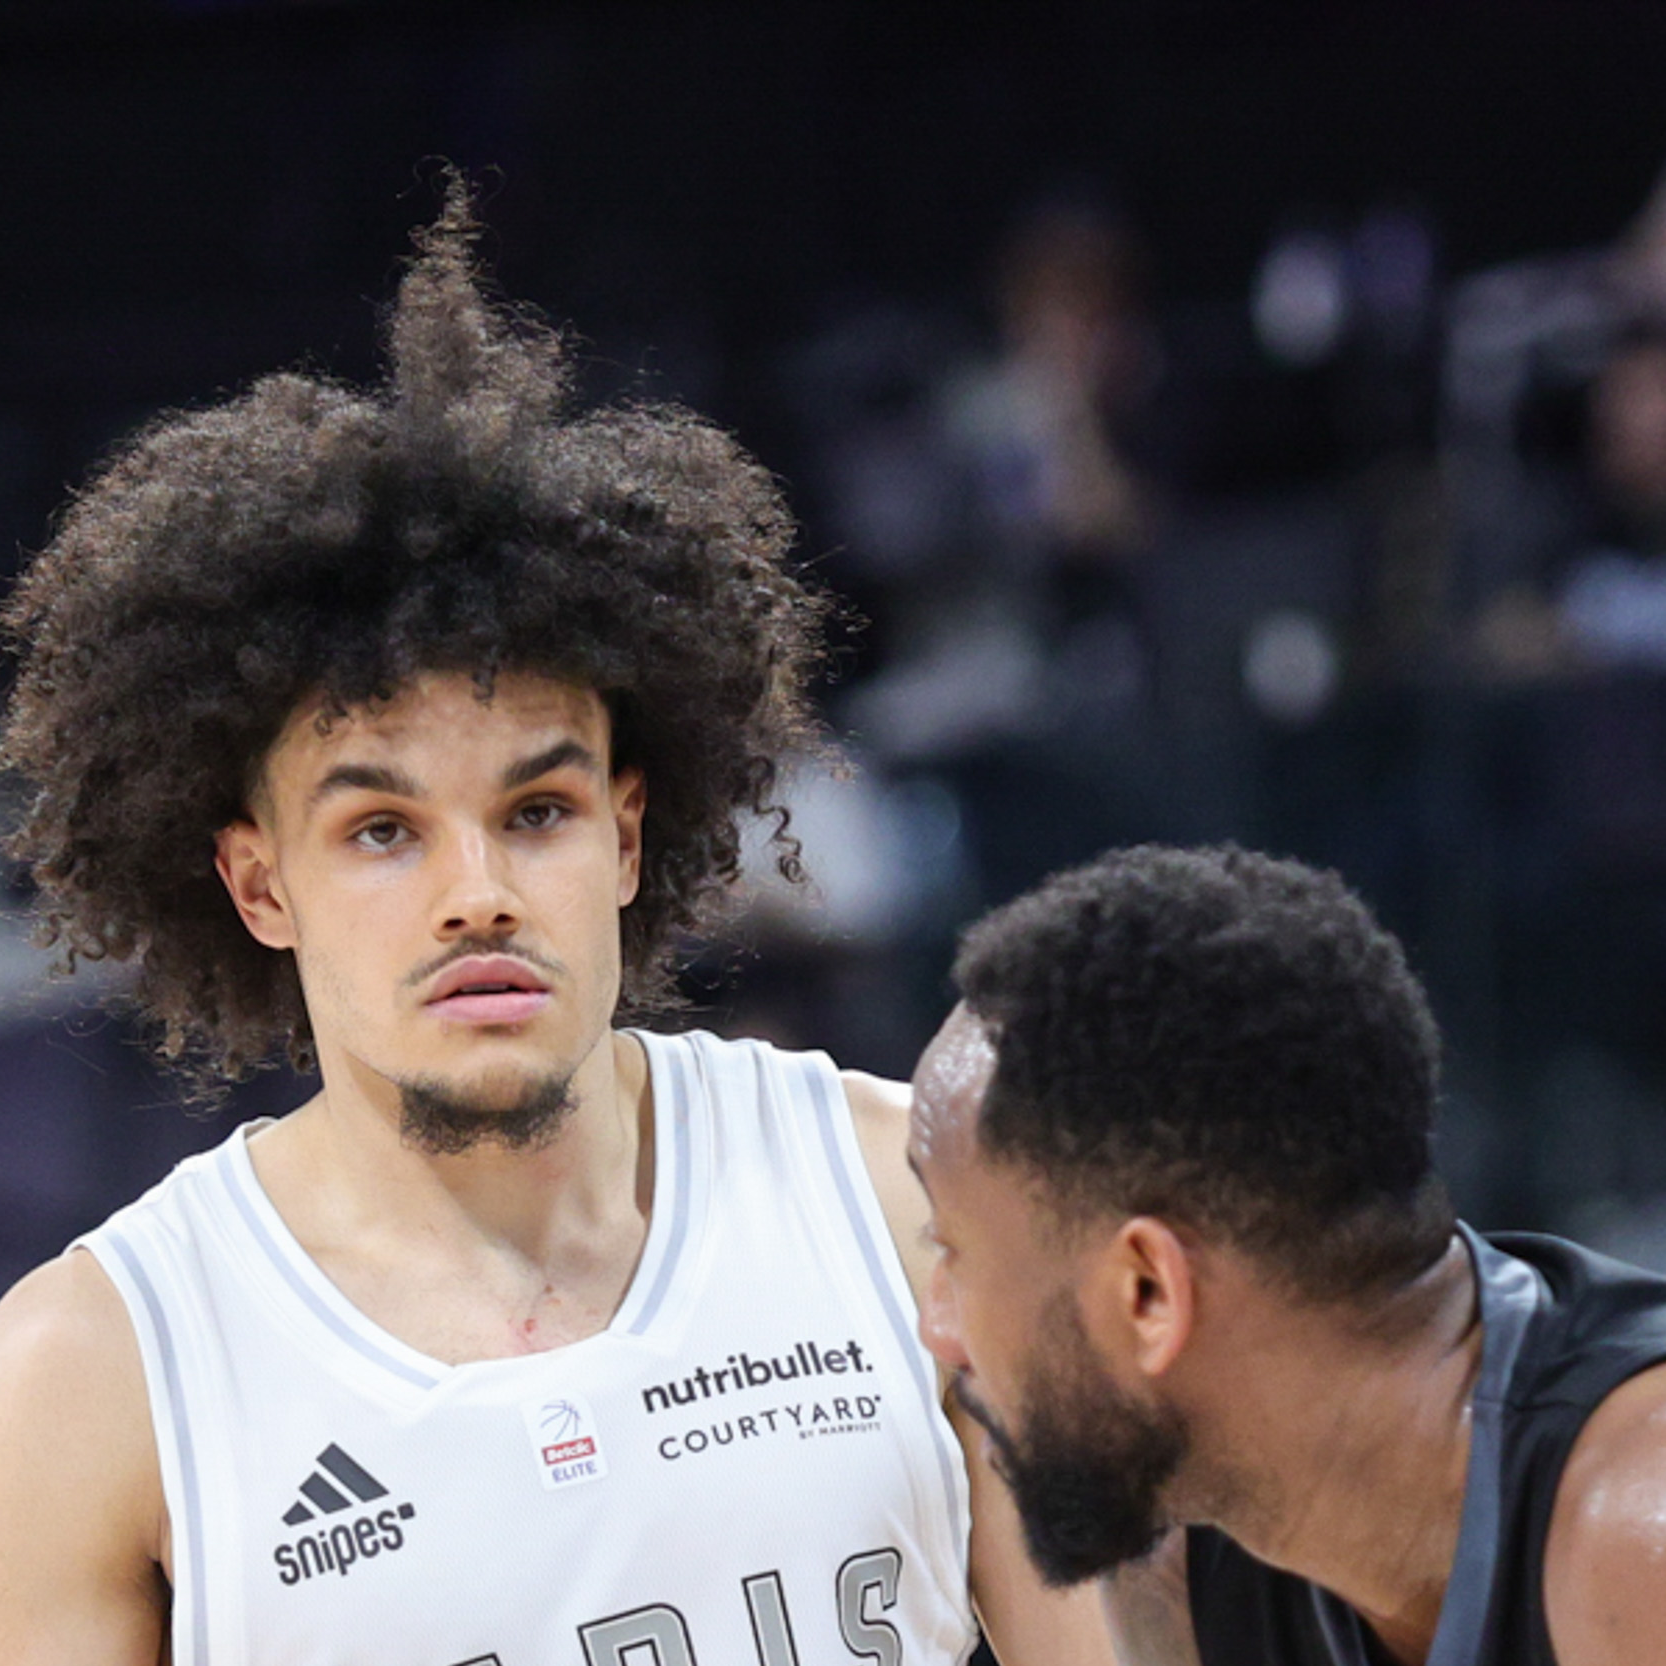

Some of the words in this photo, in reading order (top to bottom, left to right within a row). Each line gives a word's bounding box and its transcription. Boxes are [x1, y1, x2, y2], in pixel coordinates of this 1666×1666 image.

[641, 1340, 874, 1414] nutribullet.
[658, 1396, 879, 1460] COURTYARD
[273, 1509, 404, 1586] snipes
